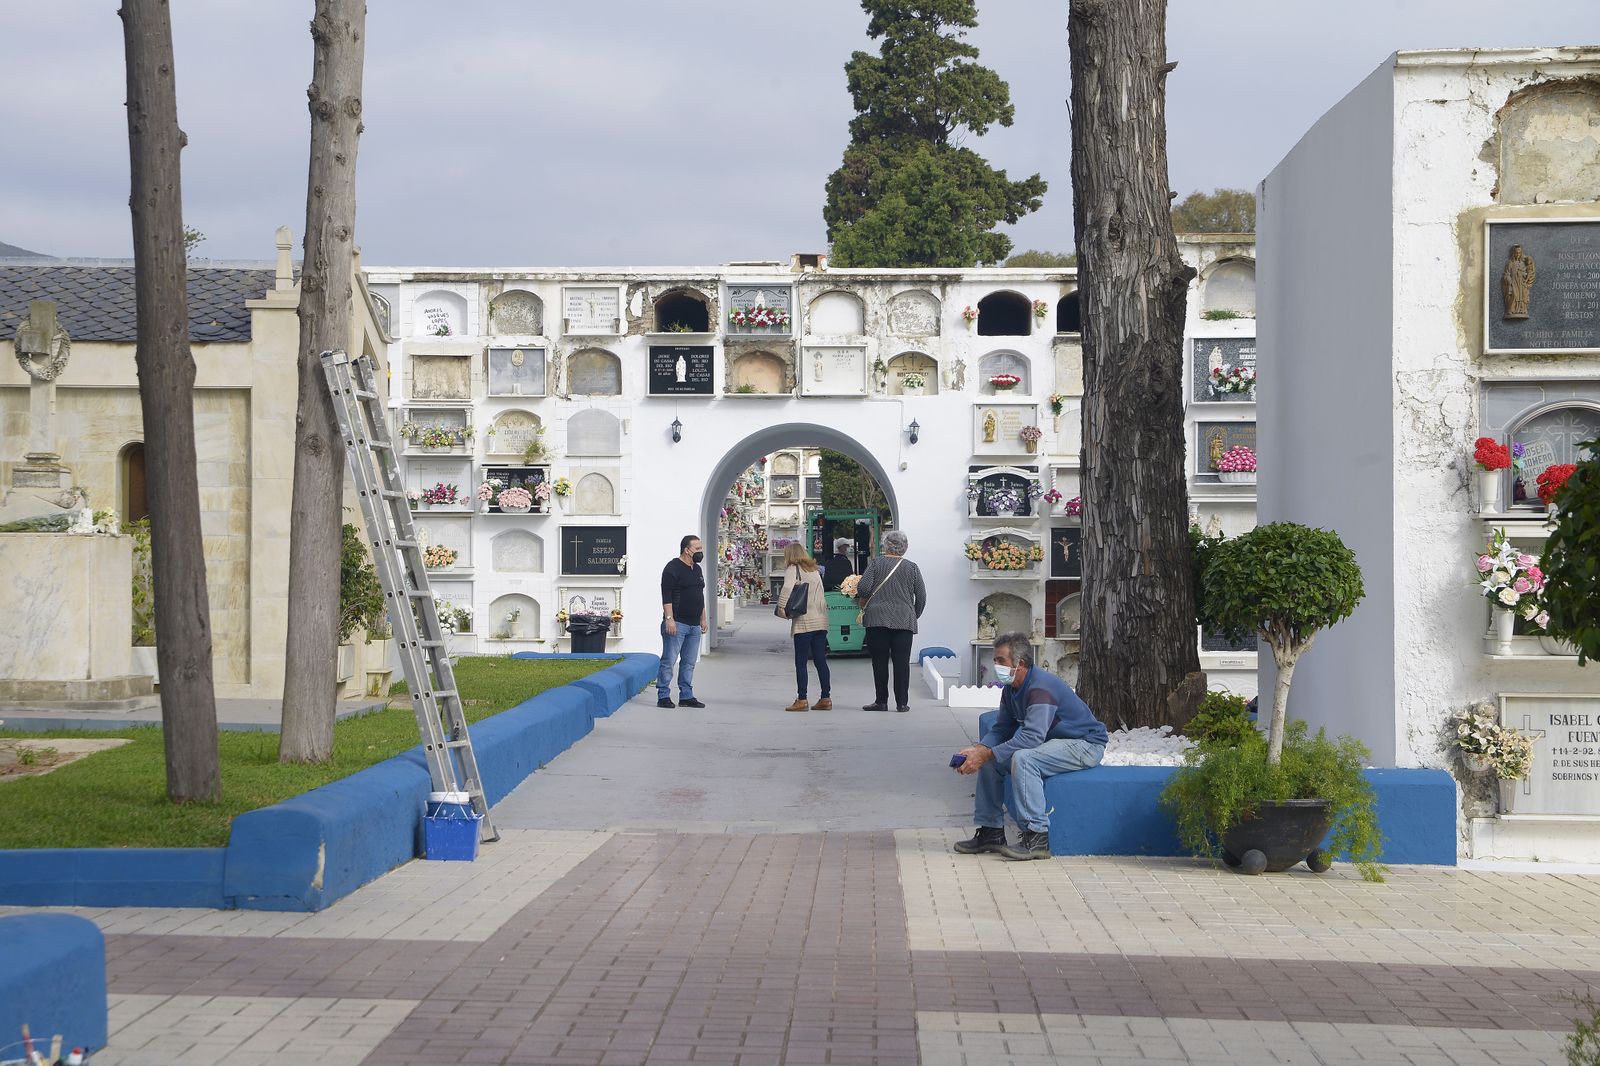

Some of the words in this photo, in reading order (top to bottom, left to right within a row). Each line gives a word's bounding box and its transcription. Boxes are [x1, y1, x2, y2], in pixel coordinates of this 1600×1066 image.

[1552, 282, 1579, 290] JOSEFA
[1563, 292, 1596, 300] MORENO
[1564, 311, 1594, 319] RESTOS
[1549, 714, 1592, 726] ISABEL
[1568, 731, 1600, 743] FUEN
[1561, 759, 1571, 767] DE
[1572, 759, 1589, 767] SUS
[1590, 759, 1600, 767] HE
[1552, 772, 1592, 781] SOBRINOS
[1594, 772, 1599, 780] Y
